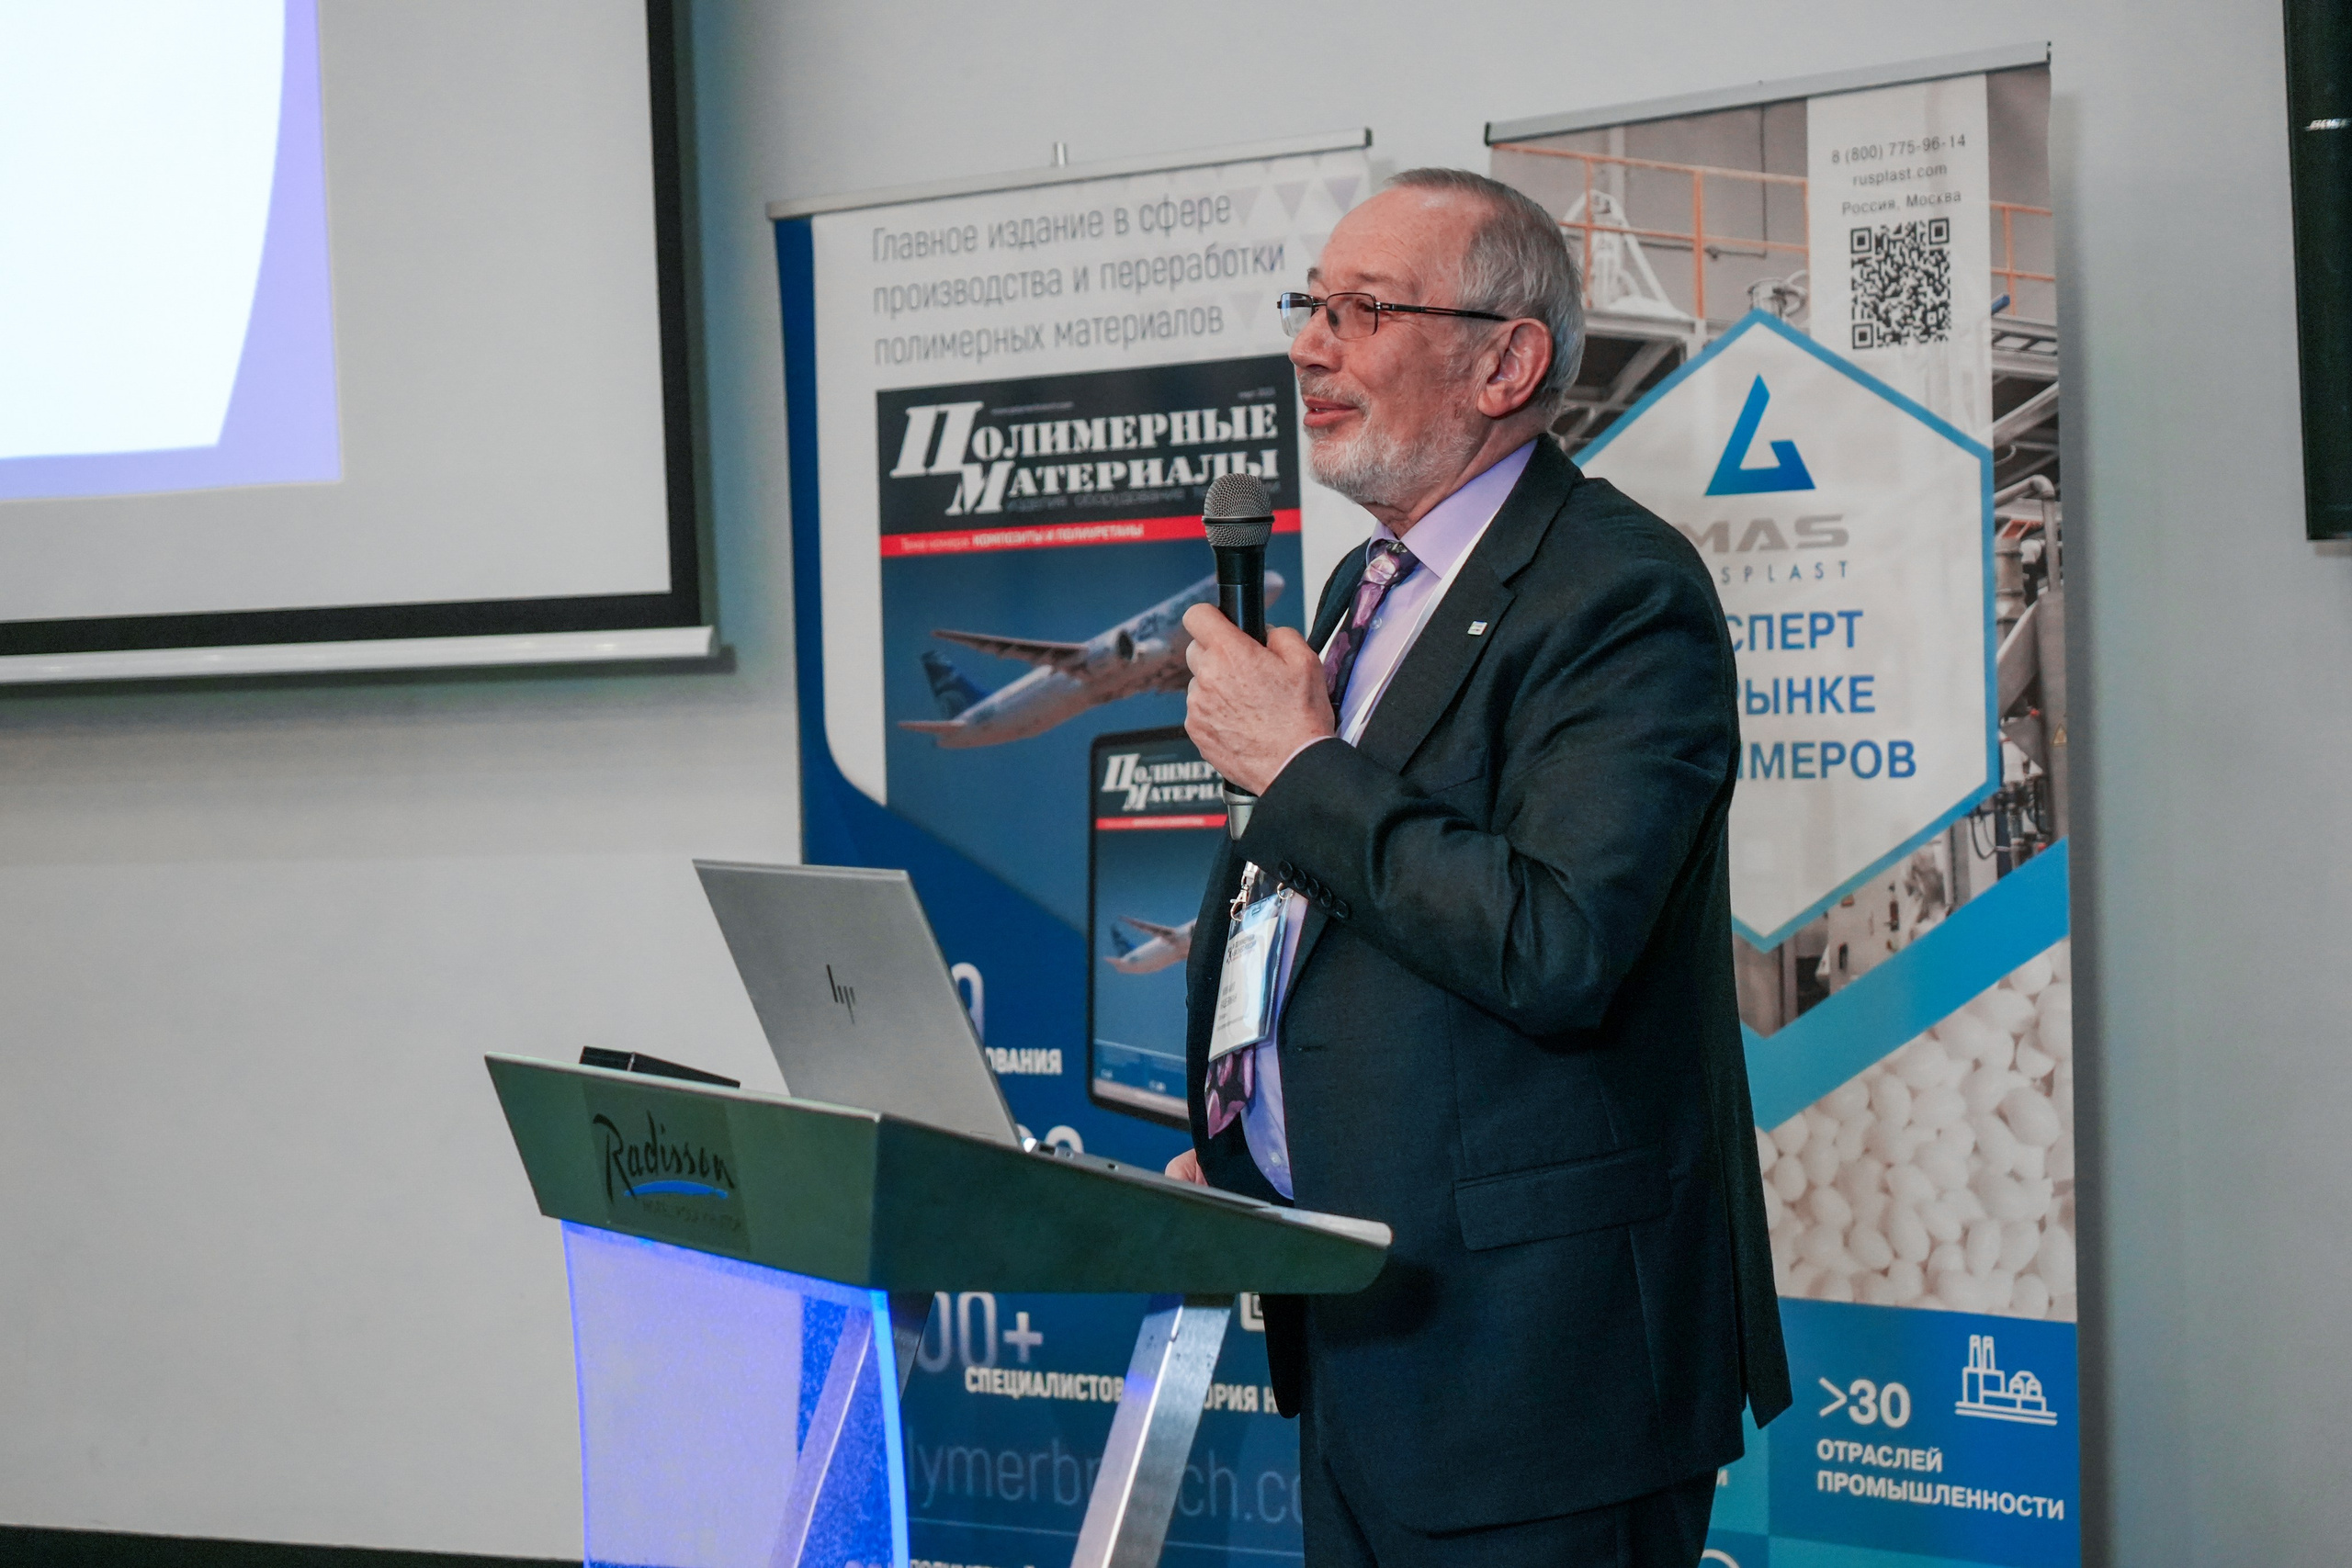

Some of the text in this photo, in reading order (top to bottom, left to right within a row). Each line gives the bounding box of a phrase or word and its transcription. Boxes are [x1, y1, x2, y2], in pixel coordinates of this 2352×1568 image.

[1831, 134, 1966, 164] 8 (800) 775-96-14
[1852, 164, 1948, 186] rusplast.com
[1842, 190, 1962, 216] Россия, Москва
[872, 193, 1232, 263] Главное издание в сфере
[873, 241, 1286, 320] производства и переработки
[874, 304, 1225, 366] полимерных материалов
[1736, 675, 1876, 716] ЫНКЕ
[1102, 753, 1223, 792] ПОЛИМЕР
[593, 1110, 735, 1204] Radisson
[966, 1365, 1124, 1403] СПЕЦИАЛИСТОВ
[1818, 1376, 1912, 1428] >30
[1816, 1437, 1943, 1473] ОТРАСЛЕЙ
[1817, 1470, 2065, 1520] ПРОМЫШЛЕННОСТИ
